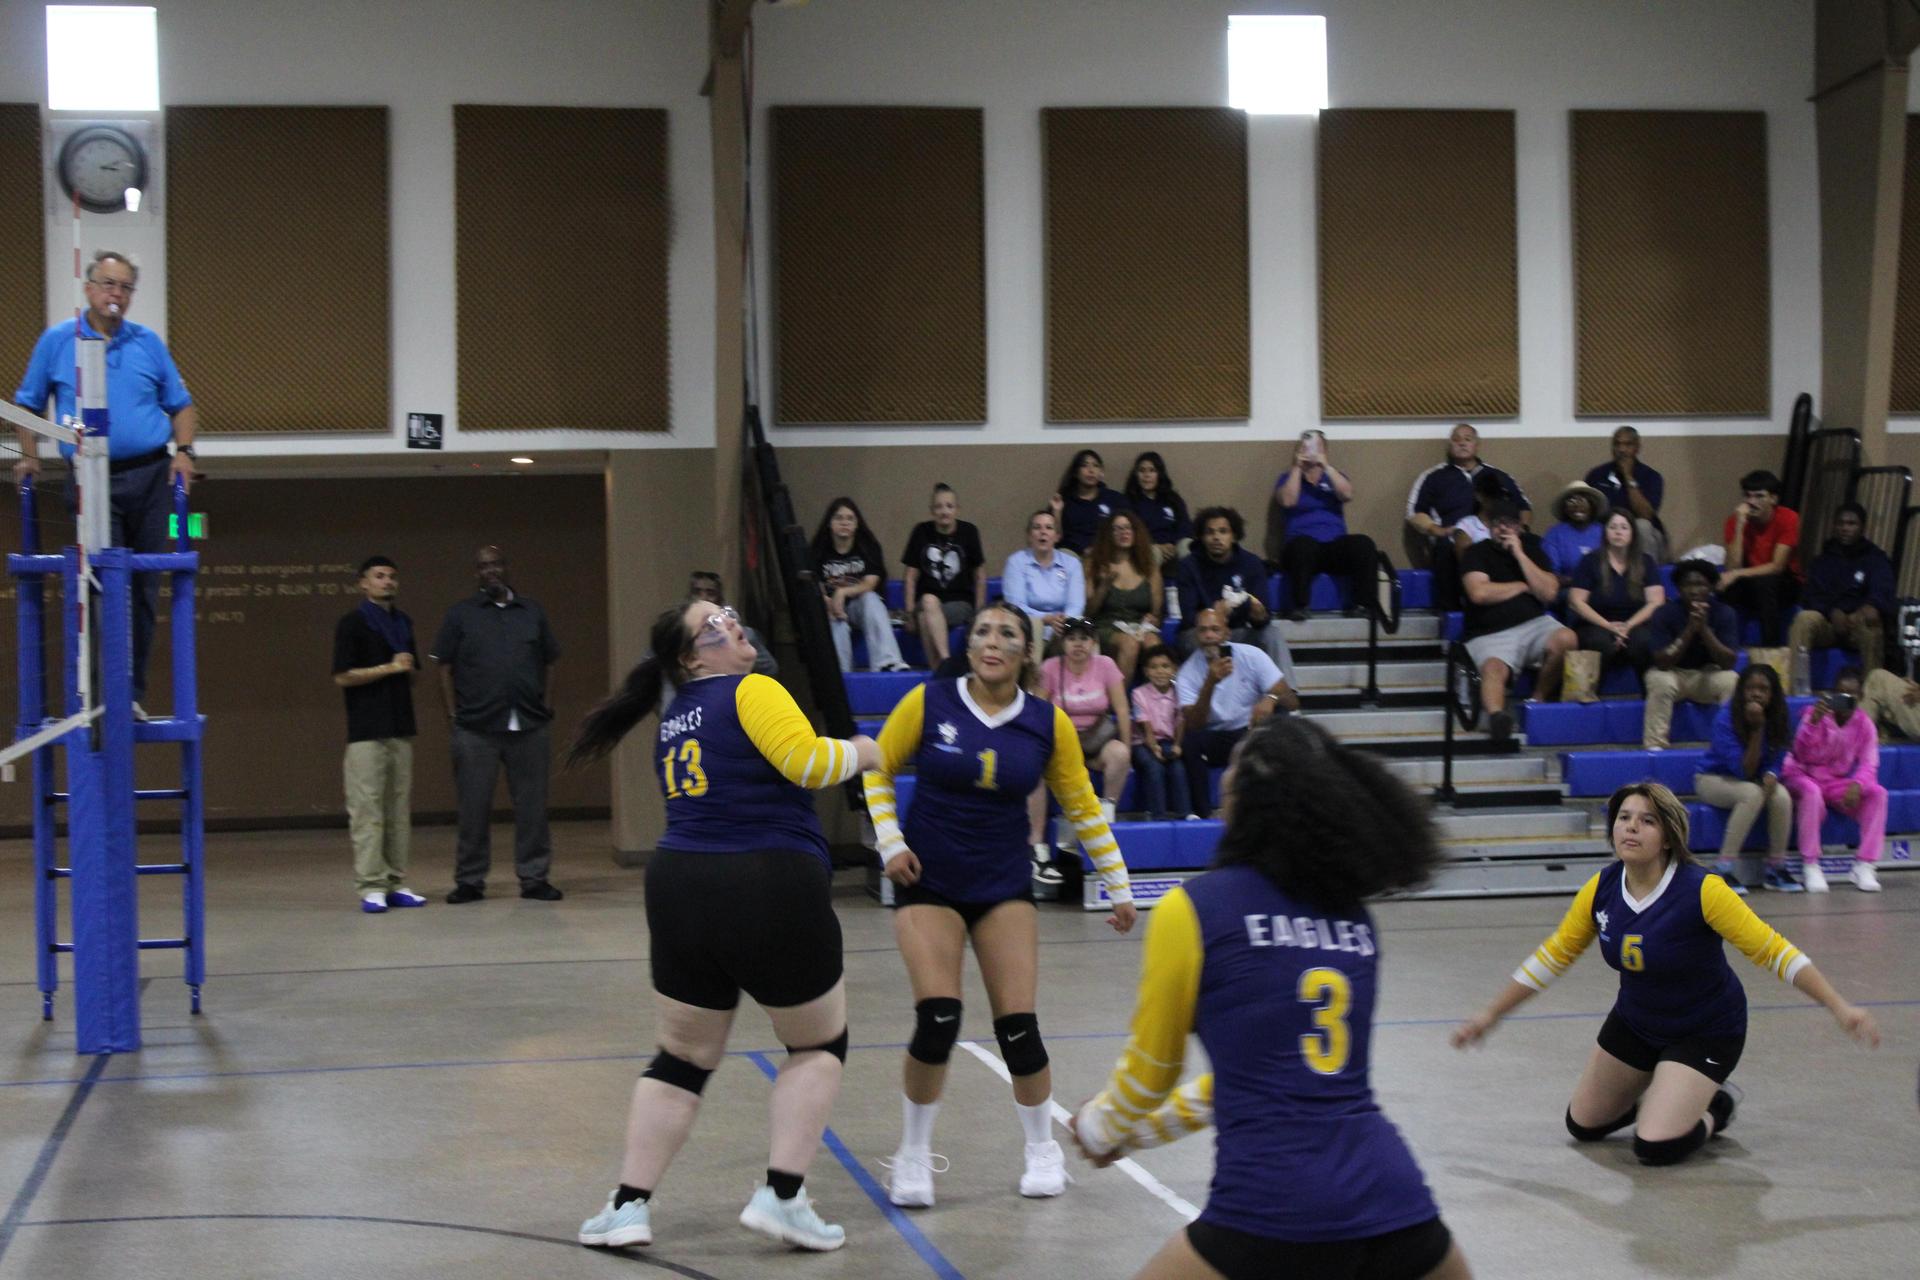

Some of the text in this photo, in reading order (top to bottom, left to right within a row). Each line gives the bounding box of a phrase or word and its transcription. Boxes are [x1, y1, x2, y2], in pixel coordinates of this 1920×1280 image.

[277, 583, 312, 596] RUN
[315, 583, 339, 596] TO
[662, 738, 709, 799] 13
[974, 747, 1000, 791] 1
[1243, 913, 1375, 957] EAGLES
[1620, 933, 1645, 973] 5
[1297, 966, 1351, 1075] 3
